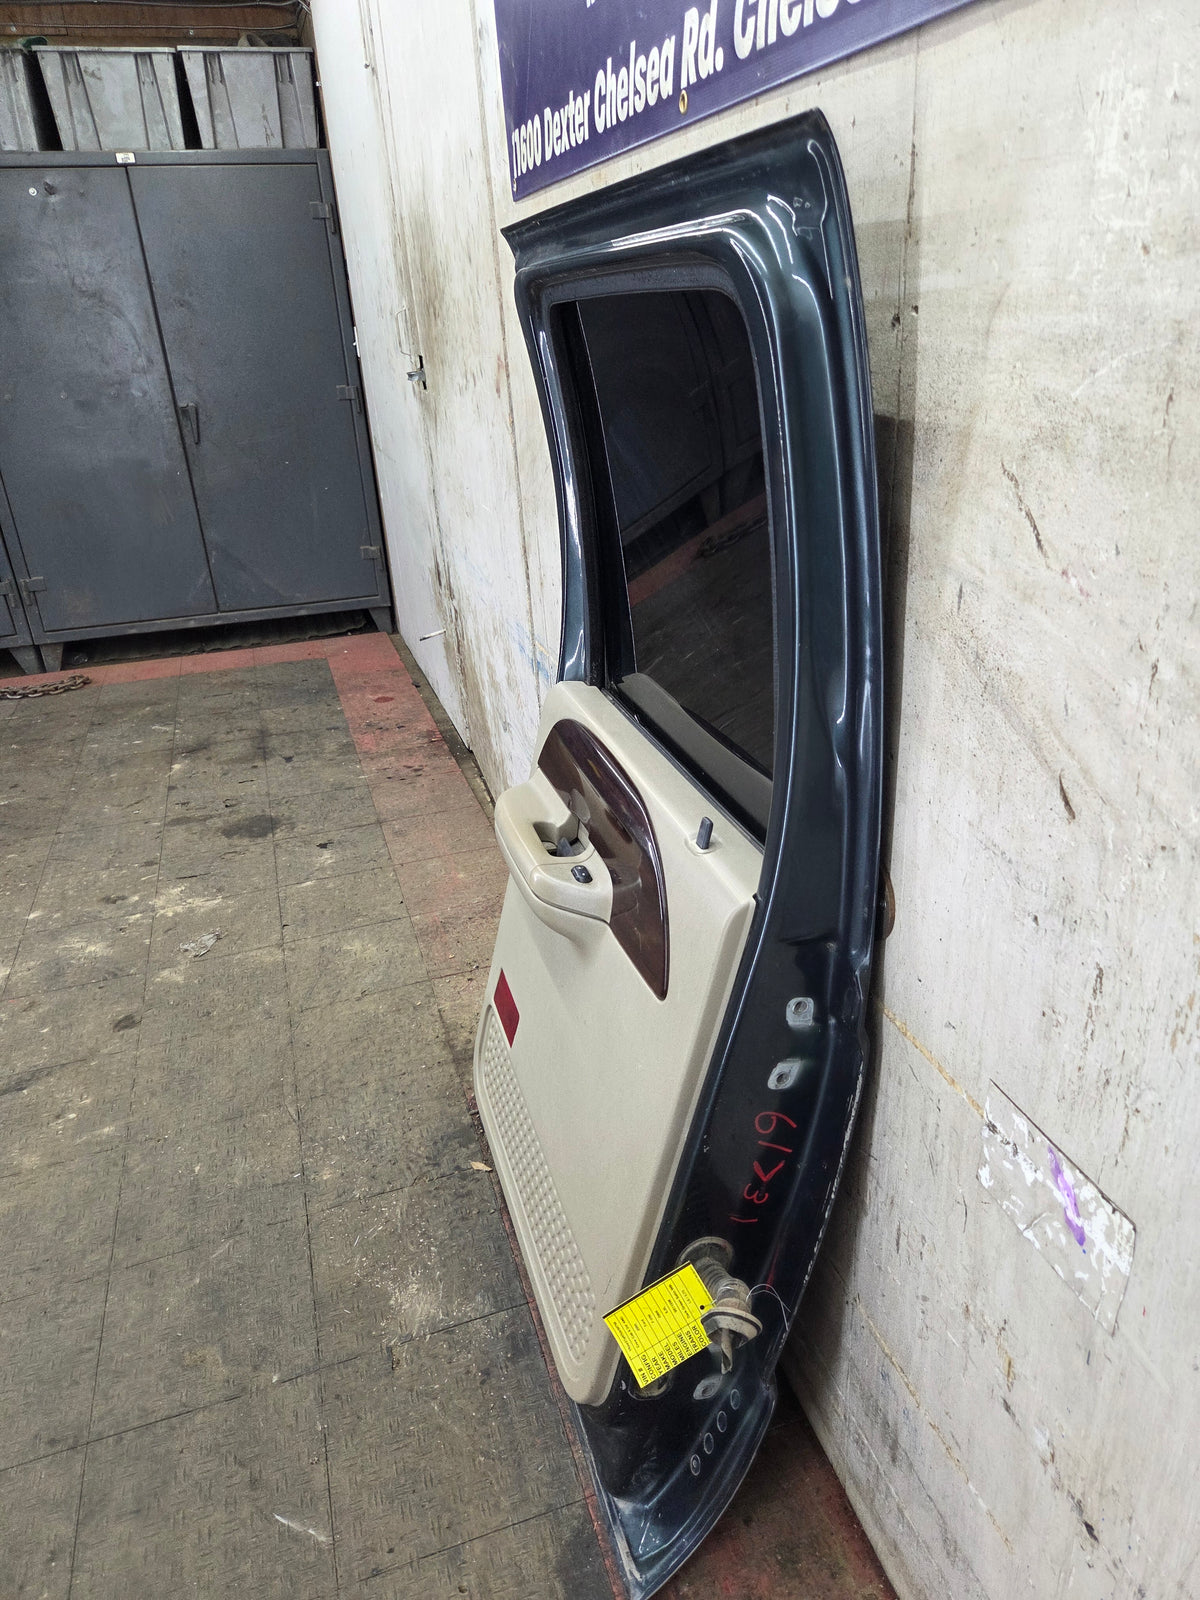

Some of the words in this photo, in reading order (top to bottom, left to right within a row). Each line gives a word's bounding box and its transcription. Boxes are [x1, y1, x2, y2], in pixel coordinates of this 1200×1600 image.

[512, 114, 541, 179] 11600
[544, 90, 590, 162] Dexter
[594, 35, 675, 133] Chelsea
[680, 0, 723, 89] Rd.
[676, 1332, 693, 1357] ENGINE
[685, 1330, 700, 1352] TRANS
[691, 1325, 707, 1347] COLOR
[658, 1351, 671, 1370] MAKE
[663, 1342, 678, 1366] MODEL
[672, 1341, 686, 1361] MILES
[640, 1354, 657, 1380] CONFIG
[651, 1356, 664, 1375] YEAR
